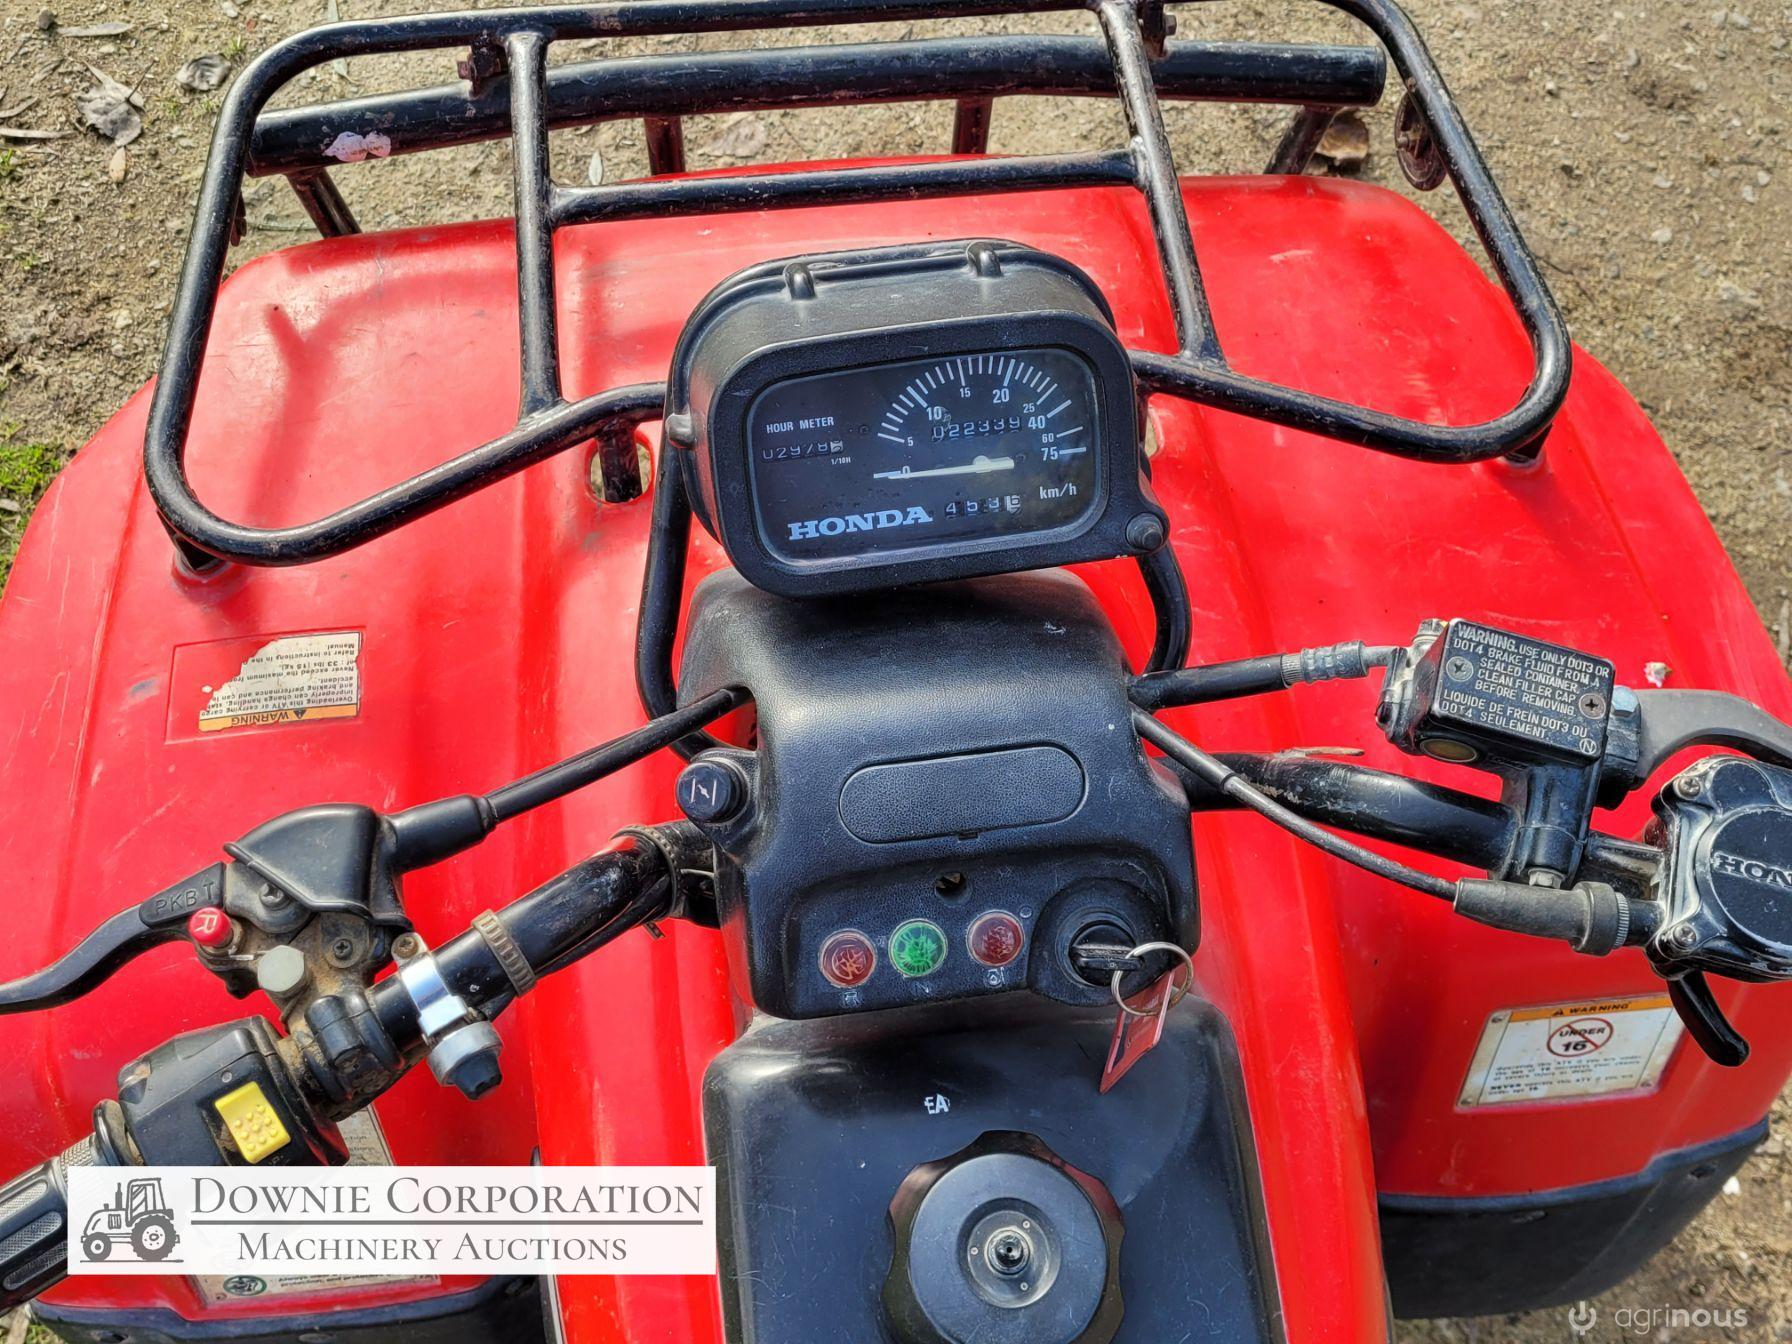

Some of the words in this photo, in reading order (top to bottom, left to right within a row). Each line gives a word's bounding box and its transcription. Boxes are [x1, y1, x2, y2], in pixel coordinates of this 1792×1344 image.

[960, 387, 971, 398] 15
[992, 388, 1010, 404] 20
[926, 406, 942, 420] 10
[1023, 402, 1035, 413] 25
[766, 421, 794, 434] HOUR
[799, 416, 834, 430] METER
[1028, 415, 1046, 430] 40
[907, 436, 914, 446] 5
[1042, 433, 1054, 443] 60
[1041, 446, 1059, 461] 75
[1040, 482, 1077, 499] km/h
[787, 506, 933, 540] HONDA
[1488, 648, 1523, 665] BRAKE
[1524, 658, 1554, 675] FLUID
[1556, 666, 1590, 685] FROM
[1591, 677, 1600, 687] A
[1519, 644, 1540, 659] USE
[1541, 651, 1567, 666] ONLY
[1567, 657, 1593, 673] DOT3
[1595, 666, 1609, 678] OR
[246, 672, 283, 681] maximum
[1480, 657, 1521, 677] SEALED
[1525, 669, 1580, 694] CONTAINER.
[255, 686, 304, 697] performance
[306, 684, 337, 692] braking
[1475, 680, 1517, 700] BEFORE
[1477, 668, 1513, 687] CLEAN
[1515, 679, 1552, 698] FILLER
[1555, 690, 1576, 703] CAP
[264, 694, 292, 703] change
[306, 696, 353, 705] Overloading
[226, 705, 258, 713] carrying
[1443, 689, 1486, 709] LIQUIDE
[1489, 702, 1504, 715] DE
[1507, 706, 1539, 724] FREIN
[1541, 716, 1569, 733] DOT3
[1572, 725, 1587, 738] OU
[231, 712, 289, 725] WARNING
[194, 914, 218, 934] R
[1570, 1003, 1629, 1014] WARNING
[1559, 1027, 1606, 1037] UNDER
[1562, 1040, 1589, 1052] 16
